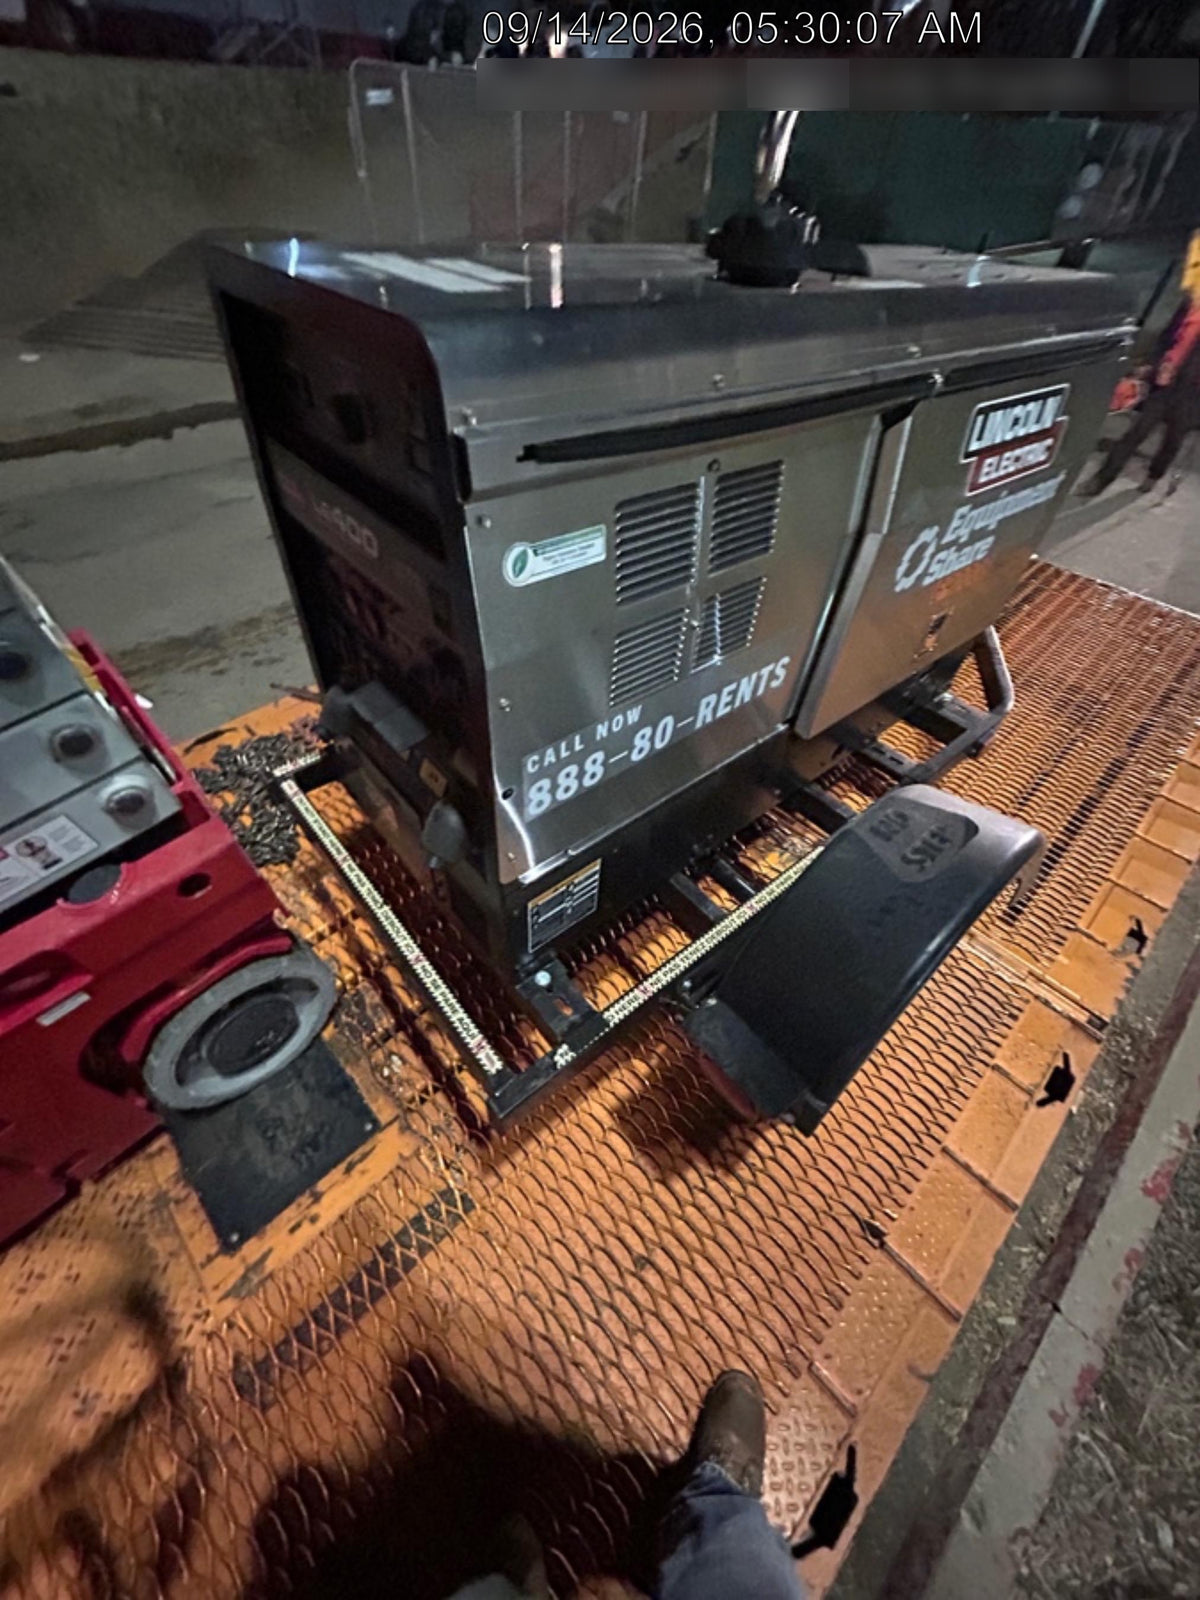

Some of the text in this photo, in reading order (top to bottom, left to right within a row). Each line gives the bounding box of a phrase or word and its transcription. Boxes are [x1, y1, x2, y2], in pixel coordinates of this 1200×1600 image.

[968, 395, 1063, 452] LINCOLN
[977, 438, 1054, 484] ELECTRIC
[941, 469, 1067, 544] Equipment
[922, 536, 995, 587] Share
[526, 704, 643, 773] CALL NOW
